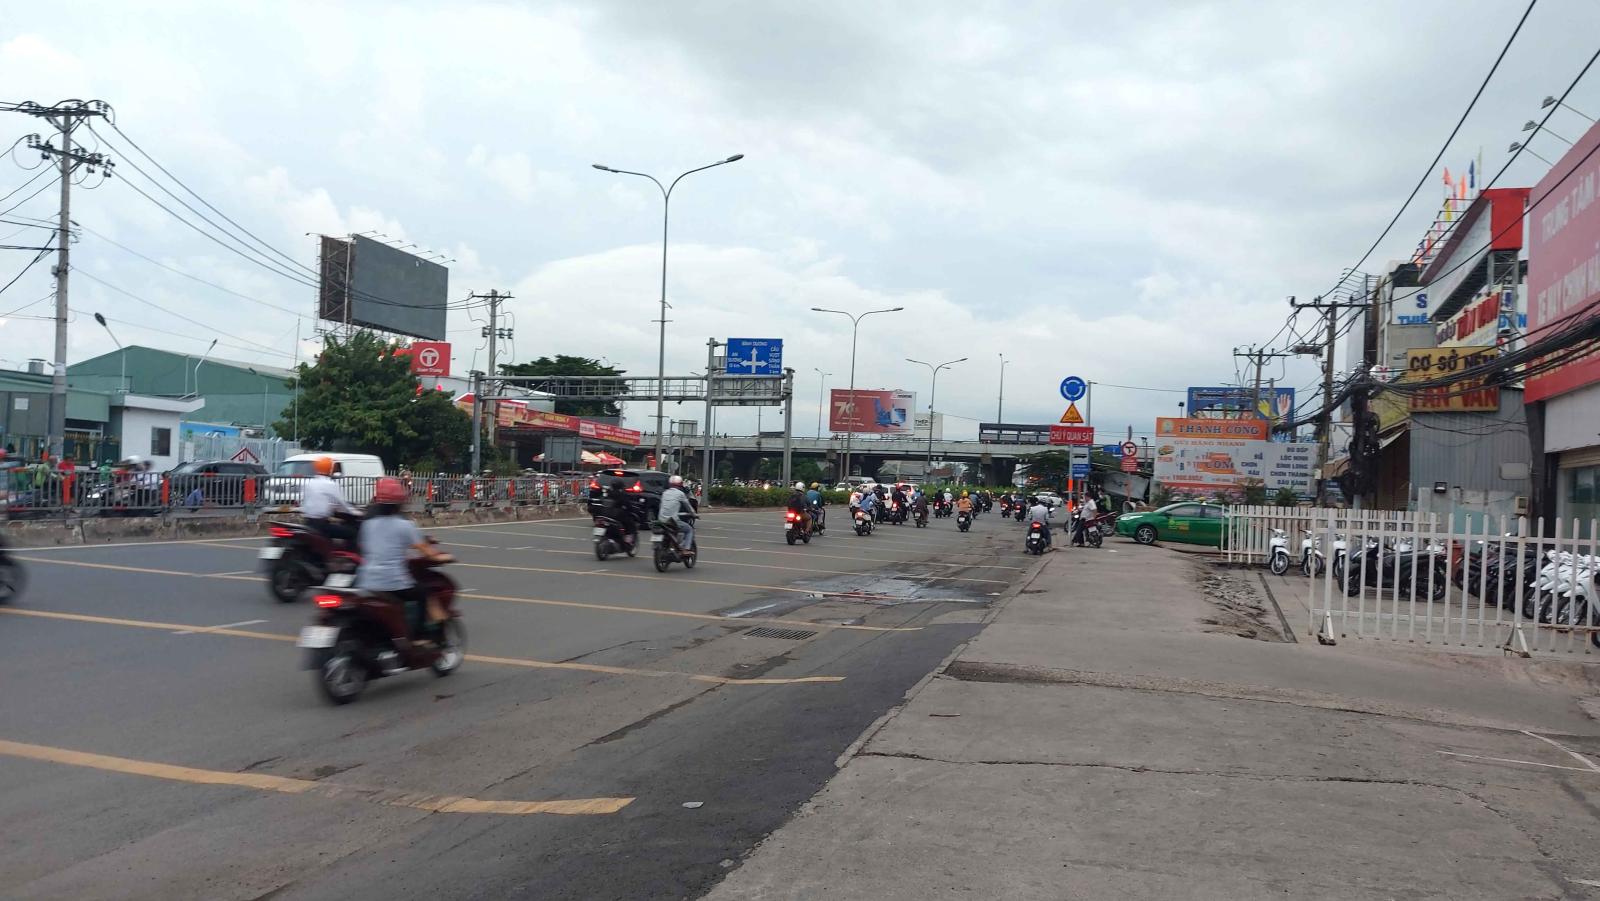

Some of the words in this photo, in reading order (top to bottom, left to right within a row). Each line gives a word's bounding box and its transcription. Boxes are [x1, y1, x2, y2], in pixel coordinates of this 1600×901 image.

[1410, 354, 1432, 371] CƠ
[1437, 349, 1459, 371] SỞ
[1051, 430, 1062, 440] CHÚ
[1067, 431, 1081, 441] QUAN
[1081, 431, 1093, 441] SÁT
